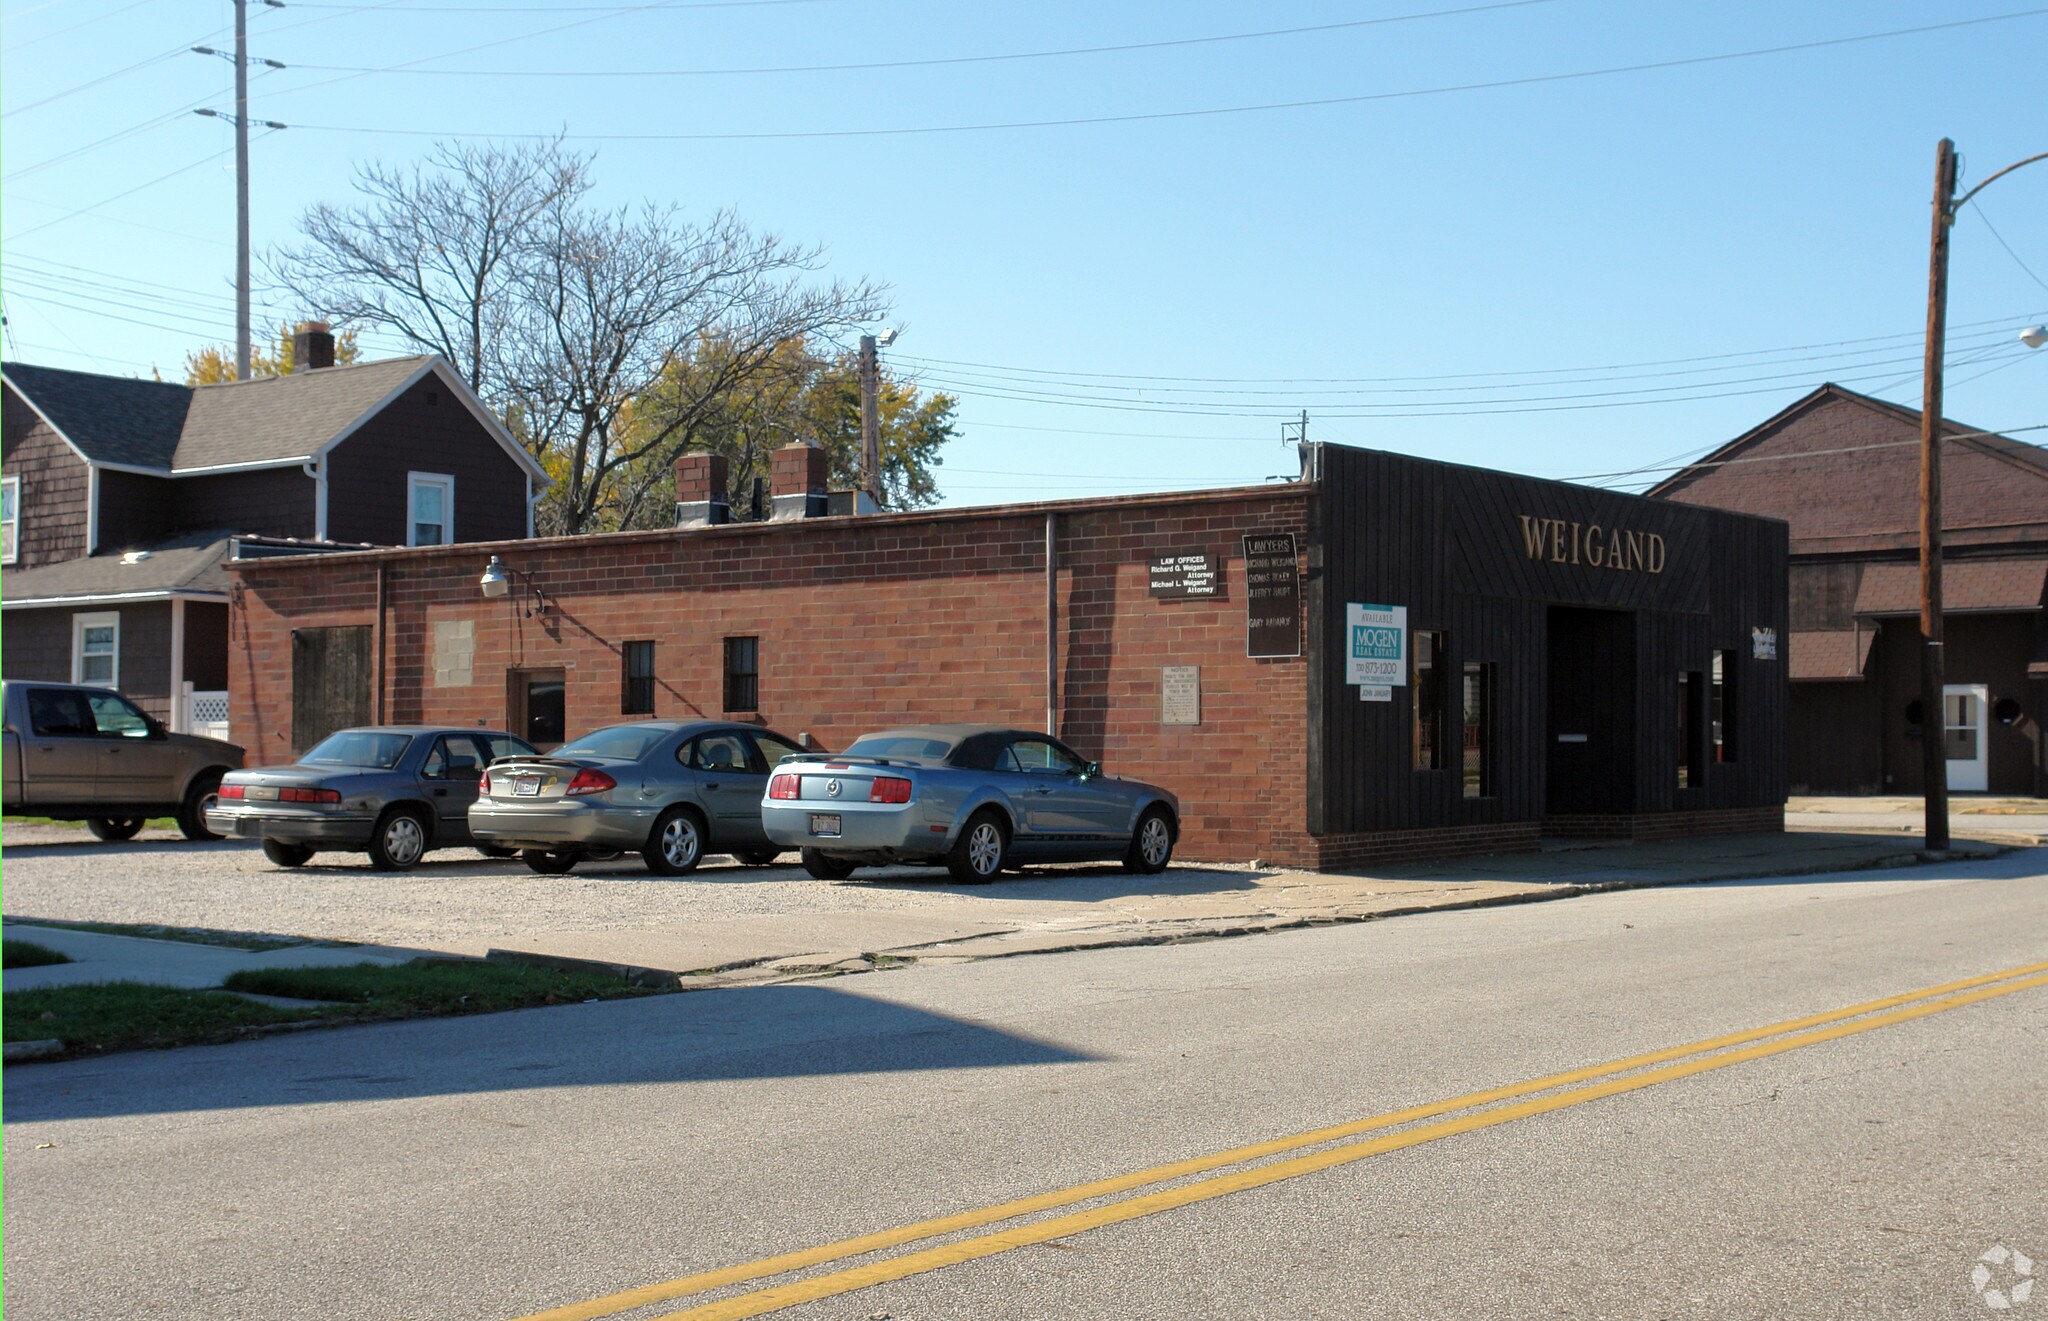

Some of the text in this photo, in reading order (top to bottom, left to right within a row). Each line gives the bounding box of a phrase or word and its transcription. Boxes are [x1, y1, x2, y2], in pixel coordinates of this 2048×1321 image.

[1248, 540, 1290, 553] LAWYERS
[1517, 515, 1666, 574] WEIGAND
[1160, 556, 1205, 565] LAW OFFICES
[1151, 565, 1173, 573] Richard
[1183, 563, 1207, 572] Weigand
[1151, 580, 1174, 588] Michael
[1183, 579, 1207, 587] Weigand
[1362, 613, 1393, 624] AVAILABLE
[1356, 628, 1398, 648] MOGEN
[1356, 646, 1397, 657] REAL ESTATE
[1365, 661, 1397, 675] 873-1200
